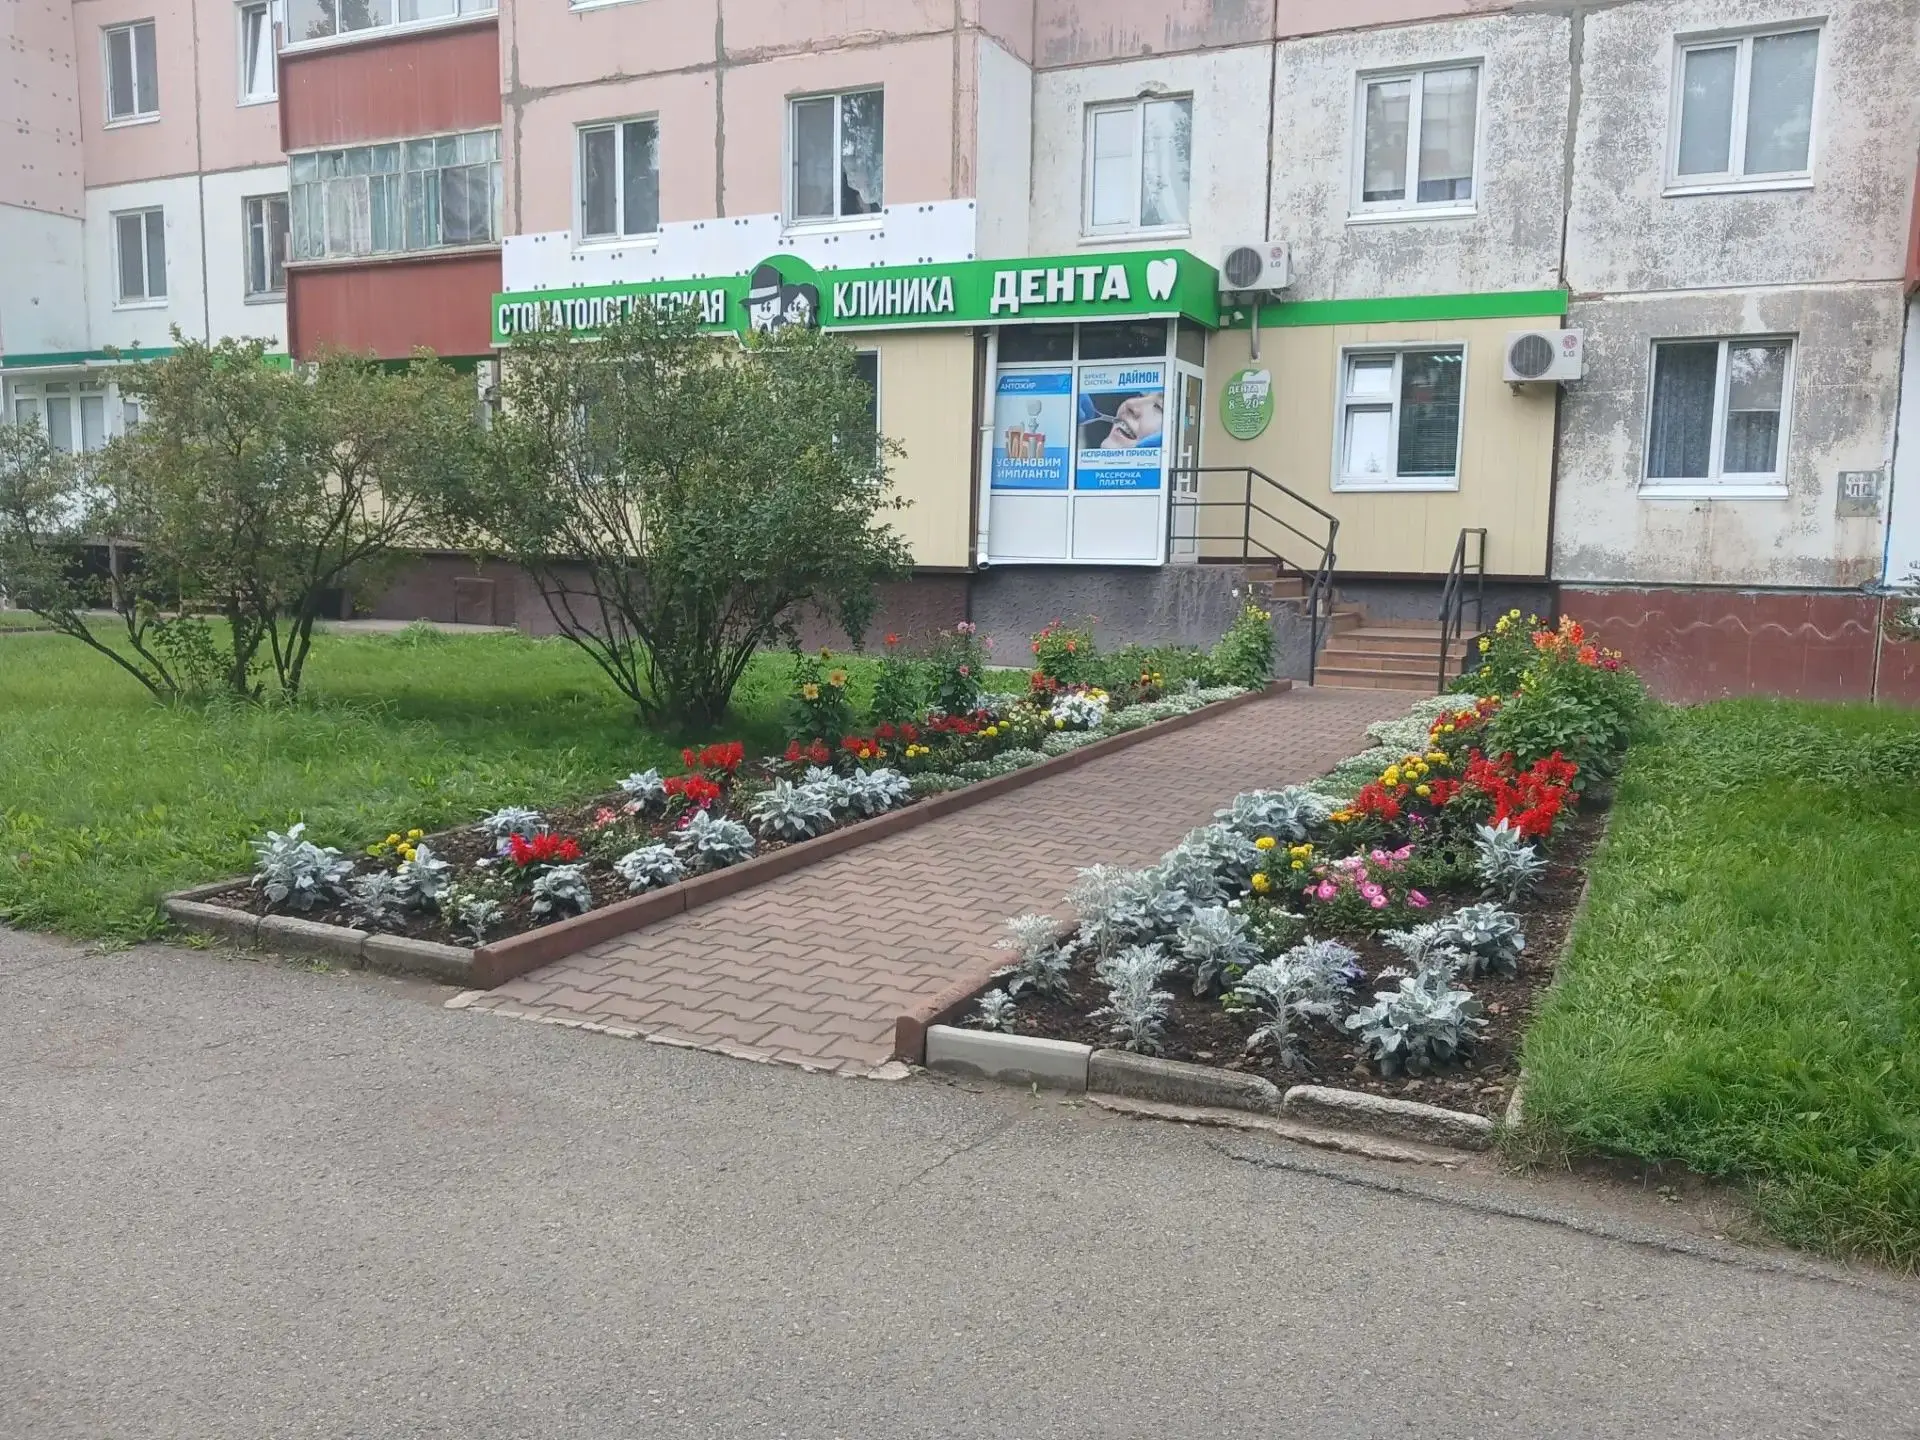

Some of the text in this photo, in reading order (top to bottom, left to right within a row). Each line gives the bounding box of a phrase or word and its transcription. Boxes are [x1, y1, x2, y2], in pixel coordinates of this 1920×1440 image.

[833, 276, 955, 318] КЛИНИКА
[989, 265, 1130, 315] ДЕНТА
[1118, 370, 1159, 386] ДАЙМОН
[1080, 449, 1158, 458] ИСПРАВИМ ПРИКУС
[996, 458, 1061, 467] УСТАНОВИМ
[997, 469, 1060, 479] ИМПЛАНТЫ
[1095, 471, 1141, 479] РАССРОЧКА
